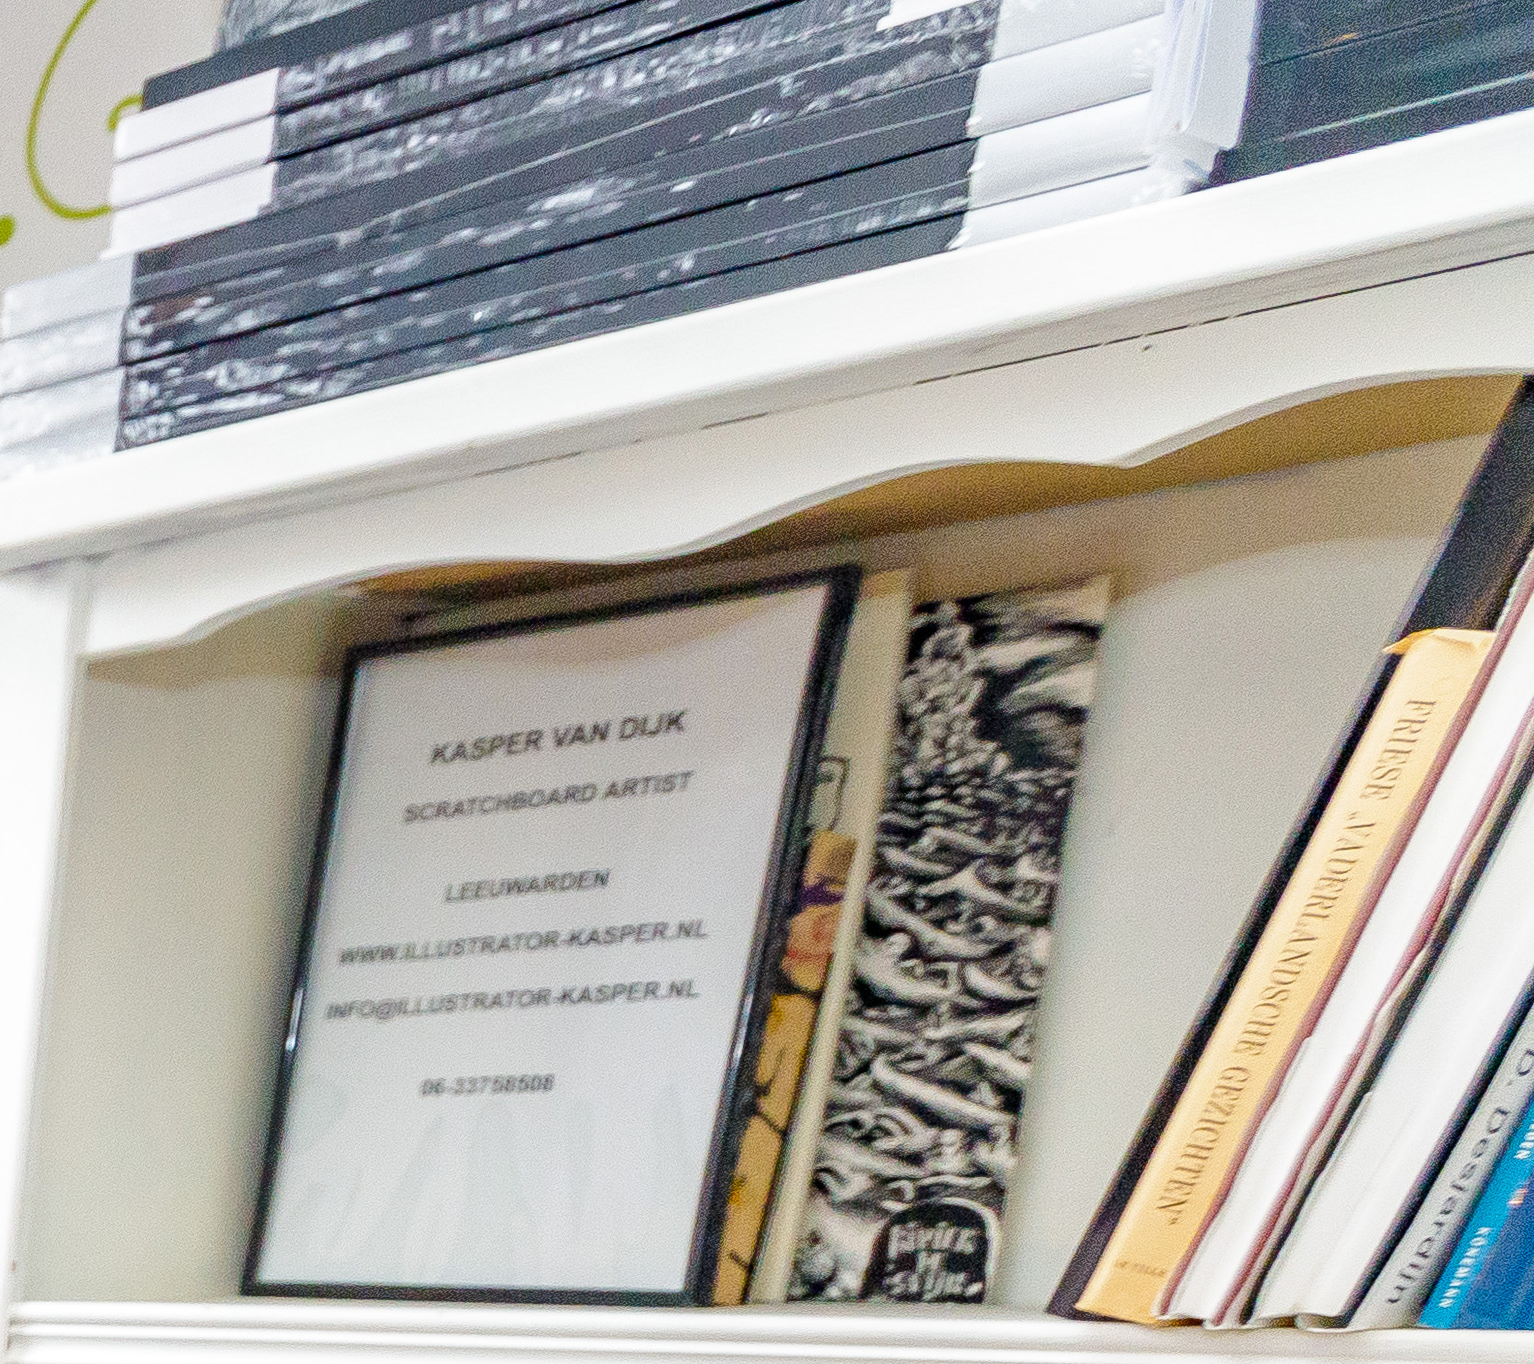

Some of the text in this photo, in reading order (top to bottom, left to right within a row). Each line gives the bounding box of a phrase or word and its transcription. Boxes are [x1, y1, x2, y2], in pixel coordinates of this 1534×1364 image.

[430, 708, 687, 764] KASPER VAN DIJK
[1359, 697, 1436, 801] FRIESE
[402, 769, 695, 824] SCRATCHBOARD ARTIST
[443, 867, 611, 903] LEEUWARDEN
[339, 918, 709, 965] WWW.ILLUSTRATOR-KASPER.NL
[323, 979, 701, 1020] INFO@ILLUSTRATOR-KASPER.NL
